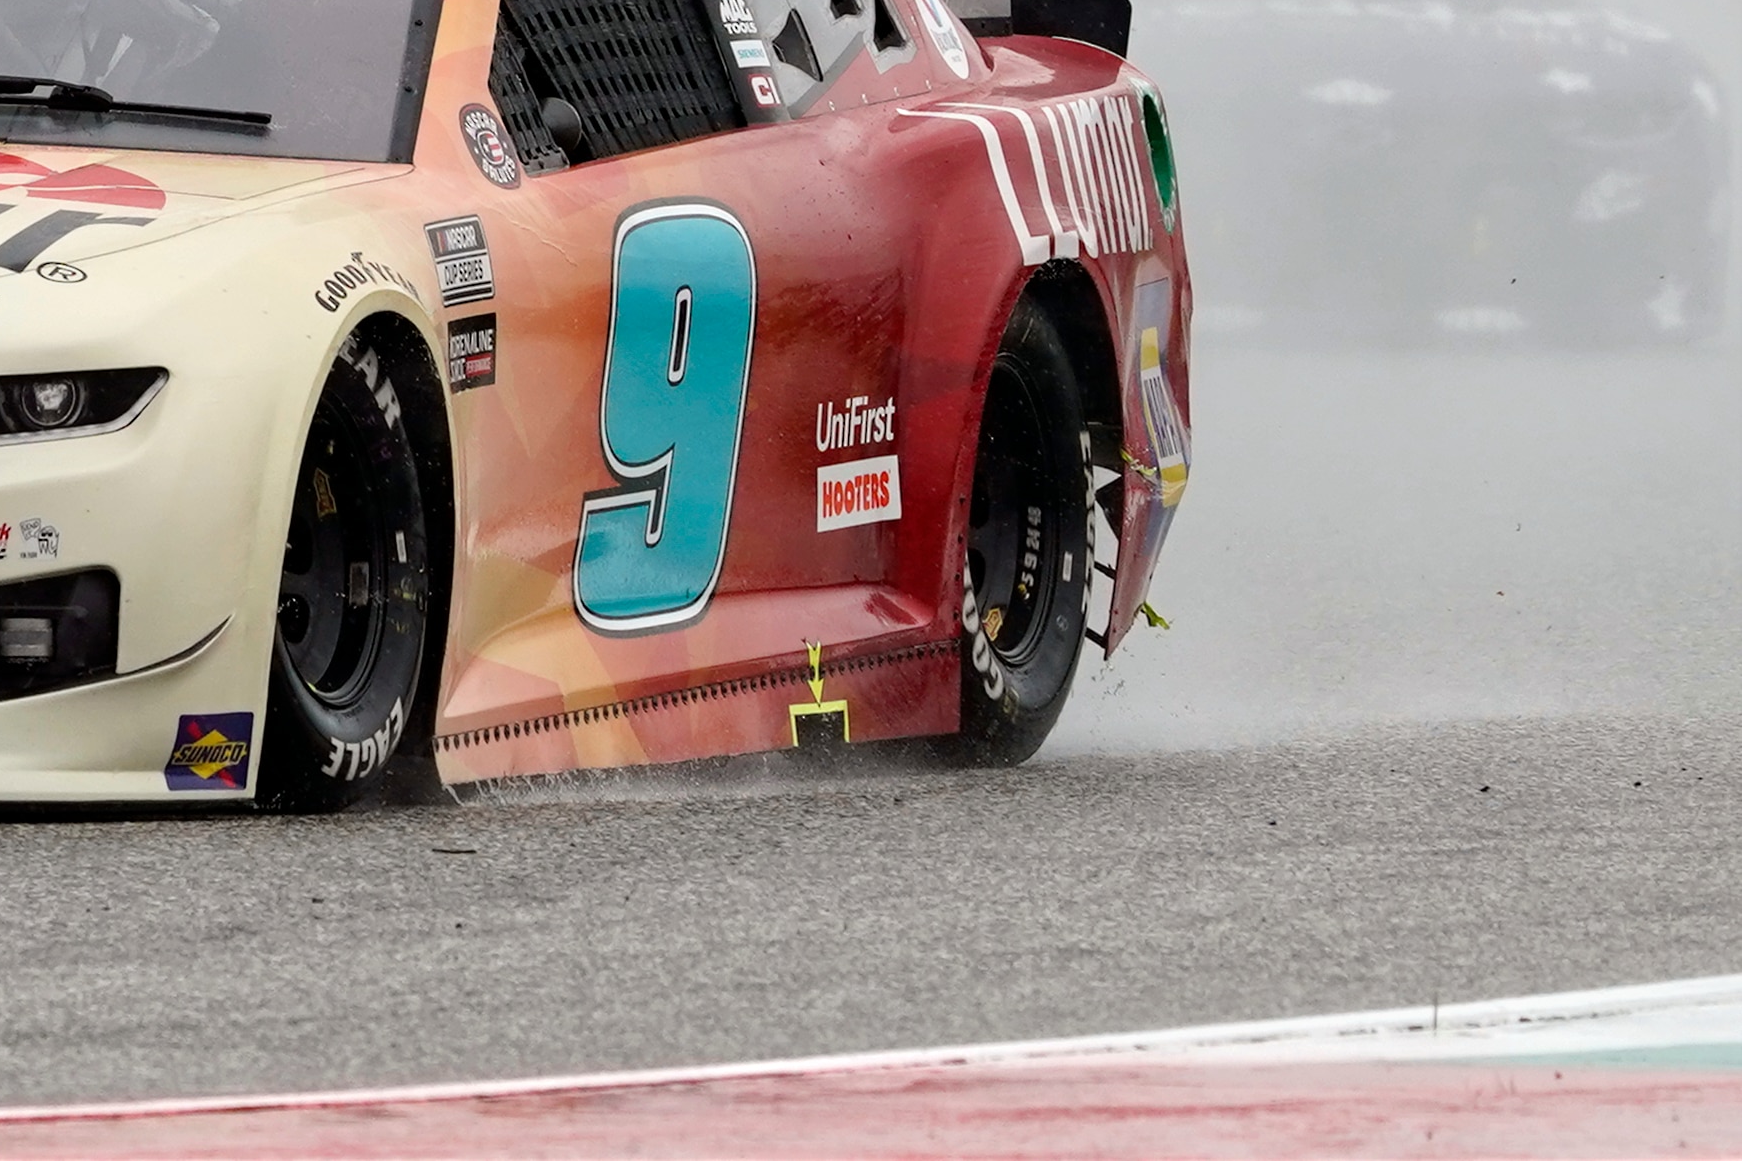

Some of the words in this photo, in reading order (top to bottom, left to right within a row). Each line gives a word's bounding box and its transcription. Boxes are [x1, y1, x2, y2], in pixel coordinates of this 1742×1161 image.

[723, 22, 757, 35] TOOLS
[464, 110, 498, 141] NASCAR
[481, 154, 516, 184] SALUTES
[442, 225, 478, 253] NASCAR
[444, 261, 459, 286] CUP
[458, 259, 484, 284] SERIES
[572, 198, 757, 636] 9
[816, 395, 896, 452] UniFirst
[822, 470, 890, 519] HOOTERS
[321, 695, 404, 781] EAGLE
[175, 743, 247, 765] SUNOCO
